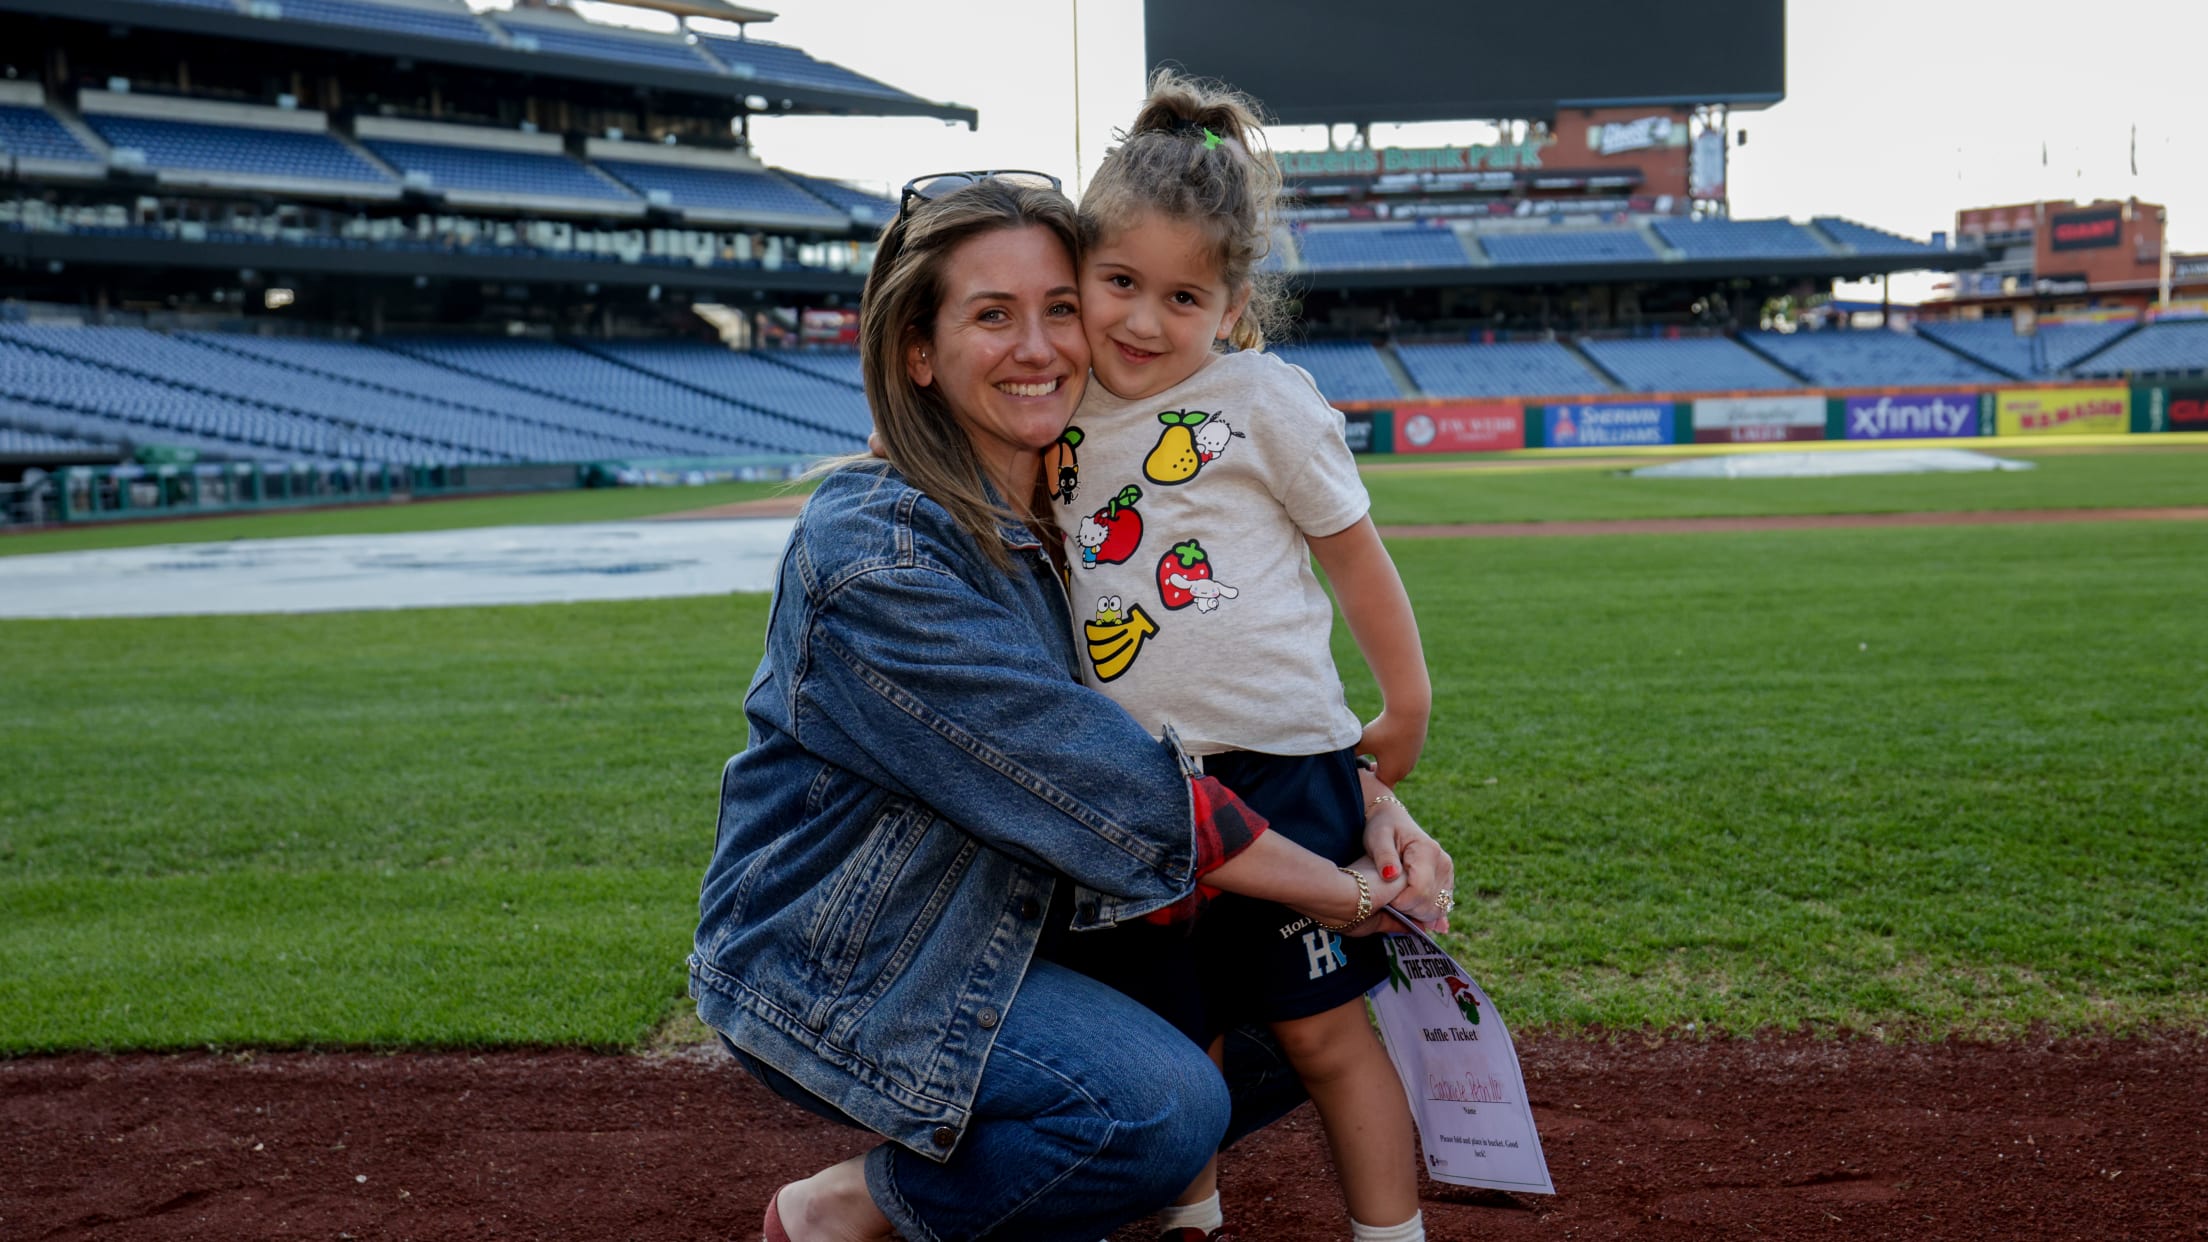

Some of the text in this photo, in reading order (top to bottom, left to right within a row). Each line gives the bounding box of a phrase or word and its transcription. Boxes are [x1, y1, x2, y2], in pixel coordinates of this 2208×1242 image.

[1276, 143, 1542, 175] itizens Bank Park
[1581, 406, 1661, 424] SHERWIN
[1852, 397, 1970, 437] xfinity
[1403, 958, 1460, 980] THE STIGMA
[1423, 1027, 1478, 1042] Raffle Ticket
